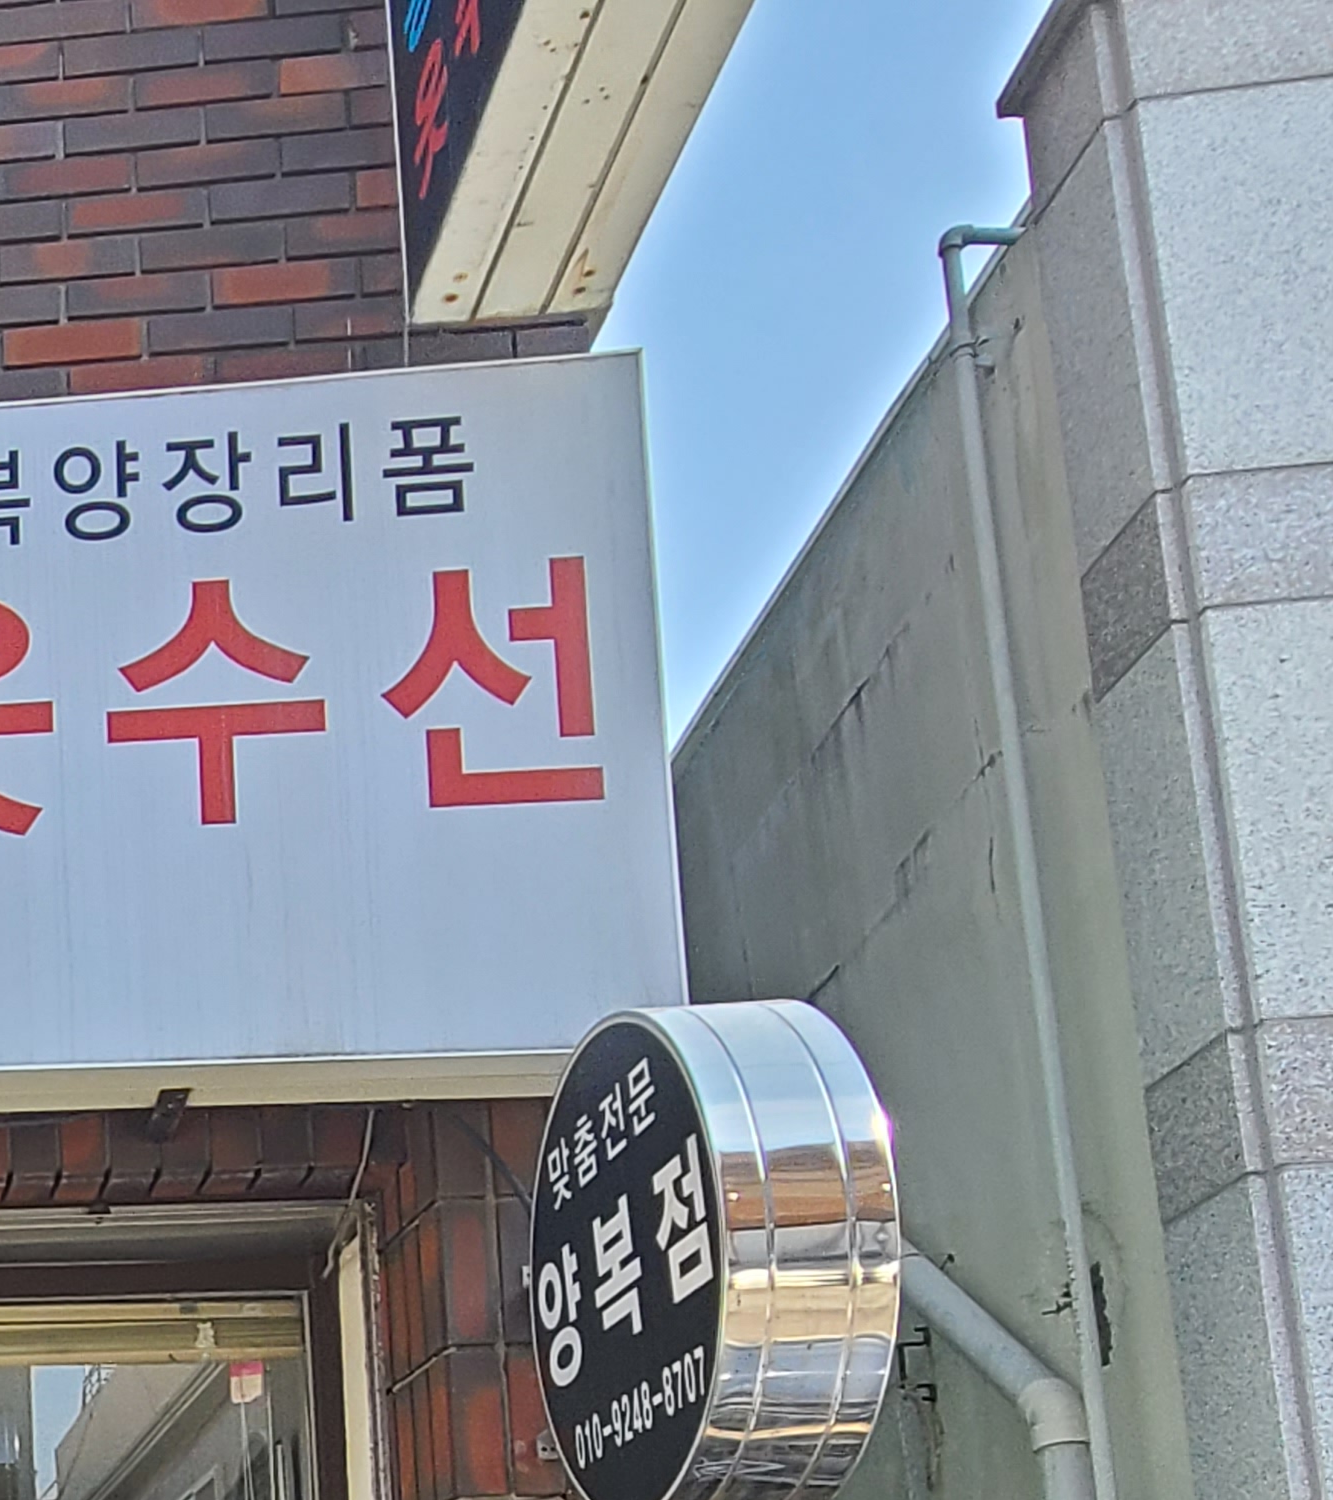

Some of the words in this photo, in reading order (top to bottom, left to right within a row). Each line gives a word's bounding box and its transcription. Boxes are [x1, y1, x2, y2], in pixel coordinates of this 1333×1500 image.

[546, 1057, 656, 1210] 맞춤전문
[538, 1133, 714, 1387] 양복점
[575, 1345, 706, 1470] 010-9248-8707
